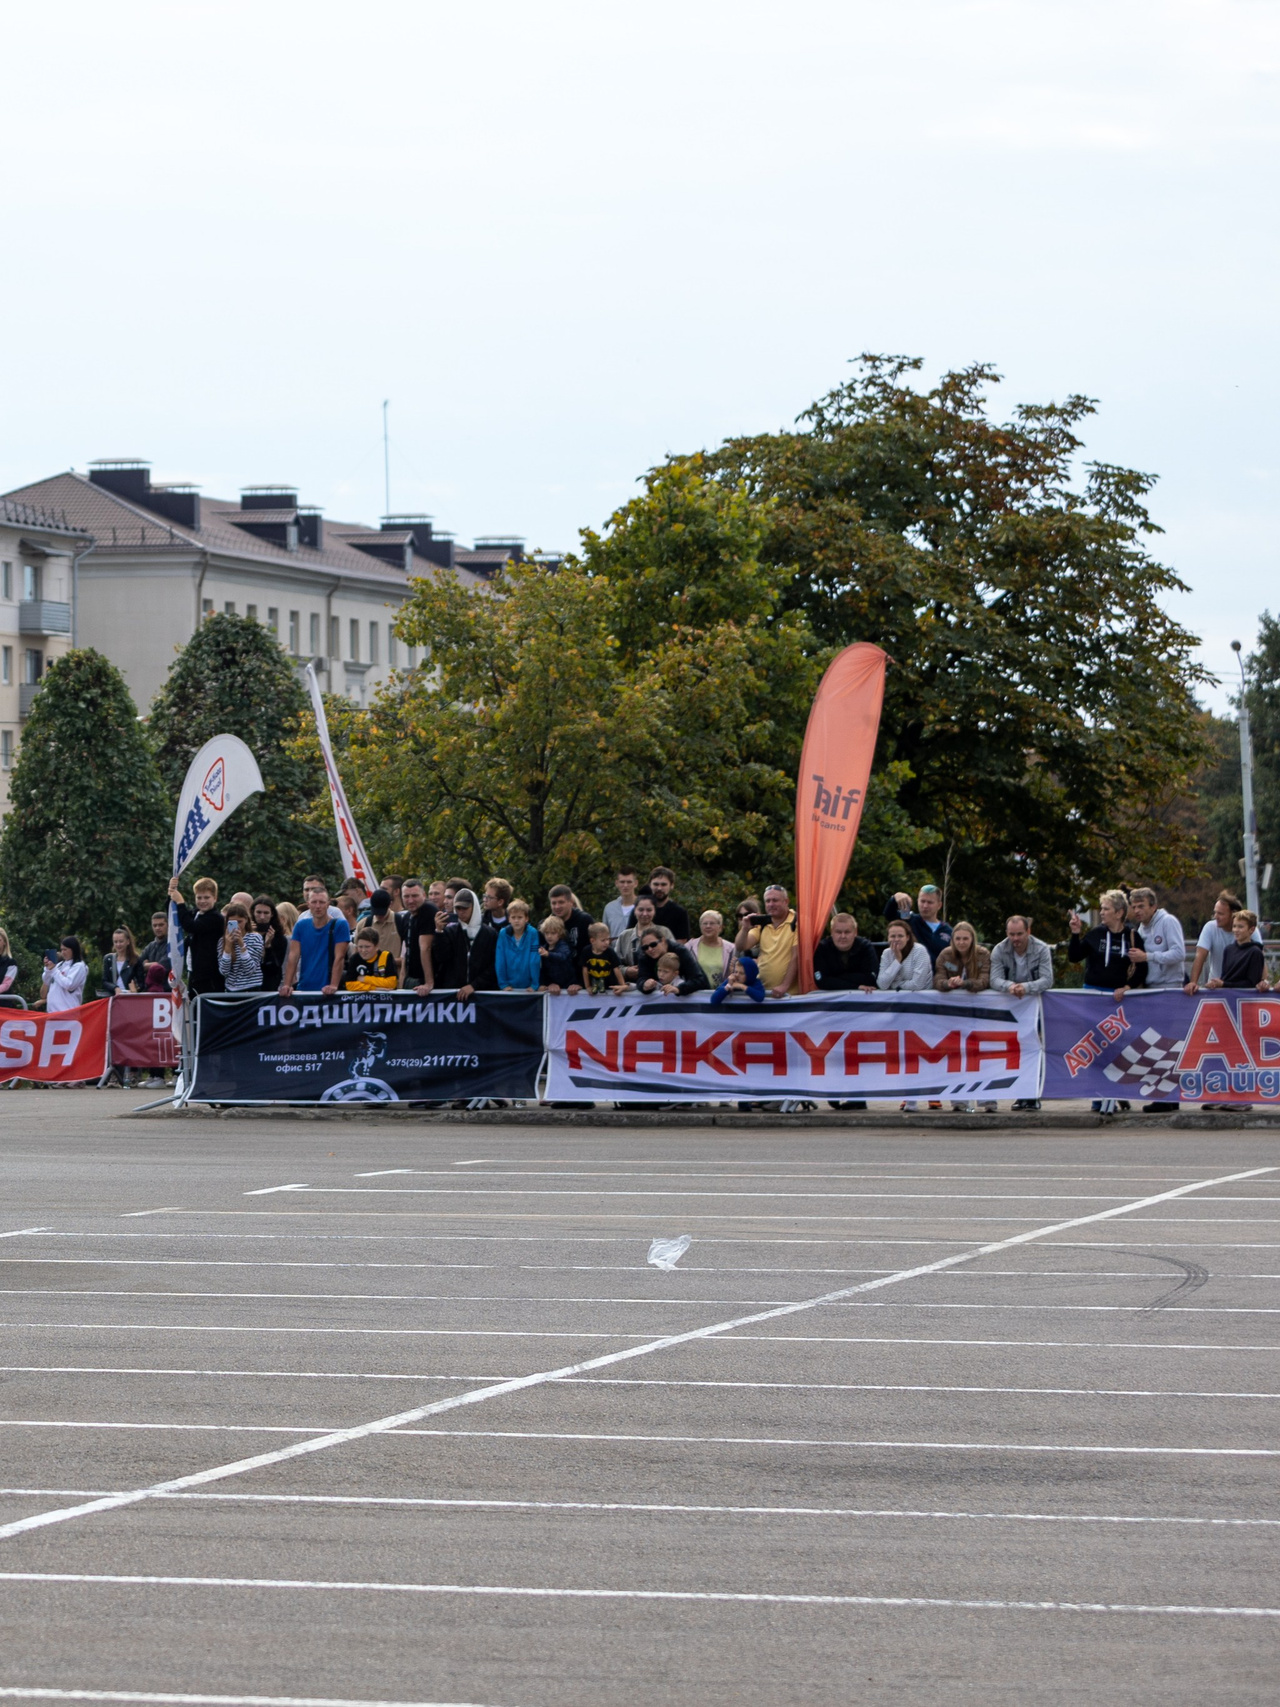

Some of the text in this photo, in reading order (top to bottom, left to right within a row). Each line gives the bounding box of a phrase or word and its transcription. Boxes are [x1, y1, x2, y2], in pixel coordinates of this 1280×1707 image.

[257, 1002, 476, 1028] ПОДШИПНИКИ
[1063, 1005, 1131, 1078] ADT.BY
[258, 1051, 345, 1063] Тимирязева 121/4
[386, 1055, 480, 1068] +375(29)2117773
[565, 1030, 1020, 1076] NAKAYAMA
[275, 1063, 322, 1073] офис 517
